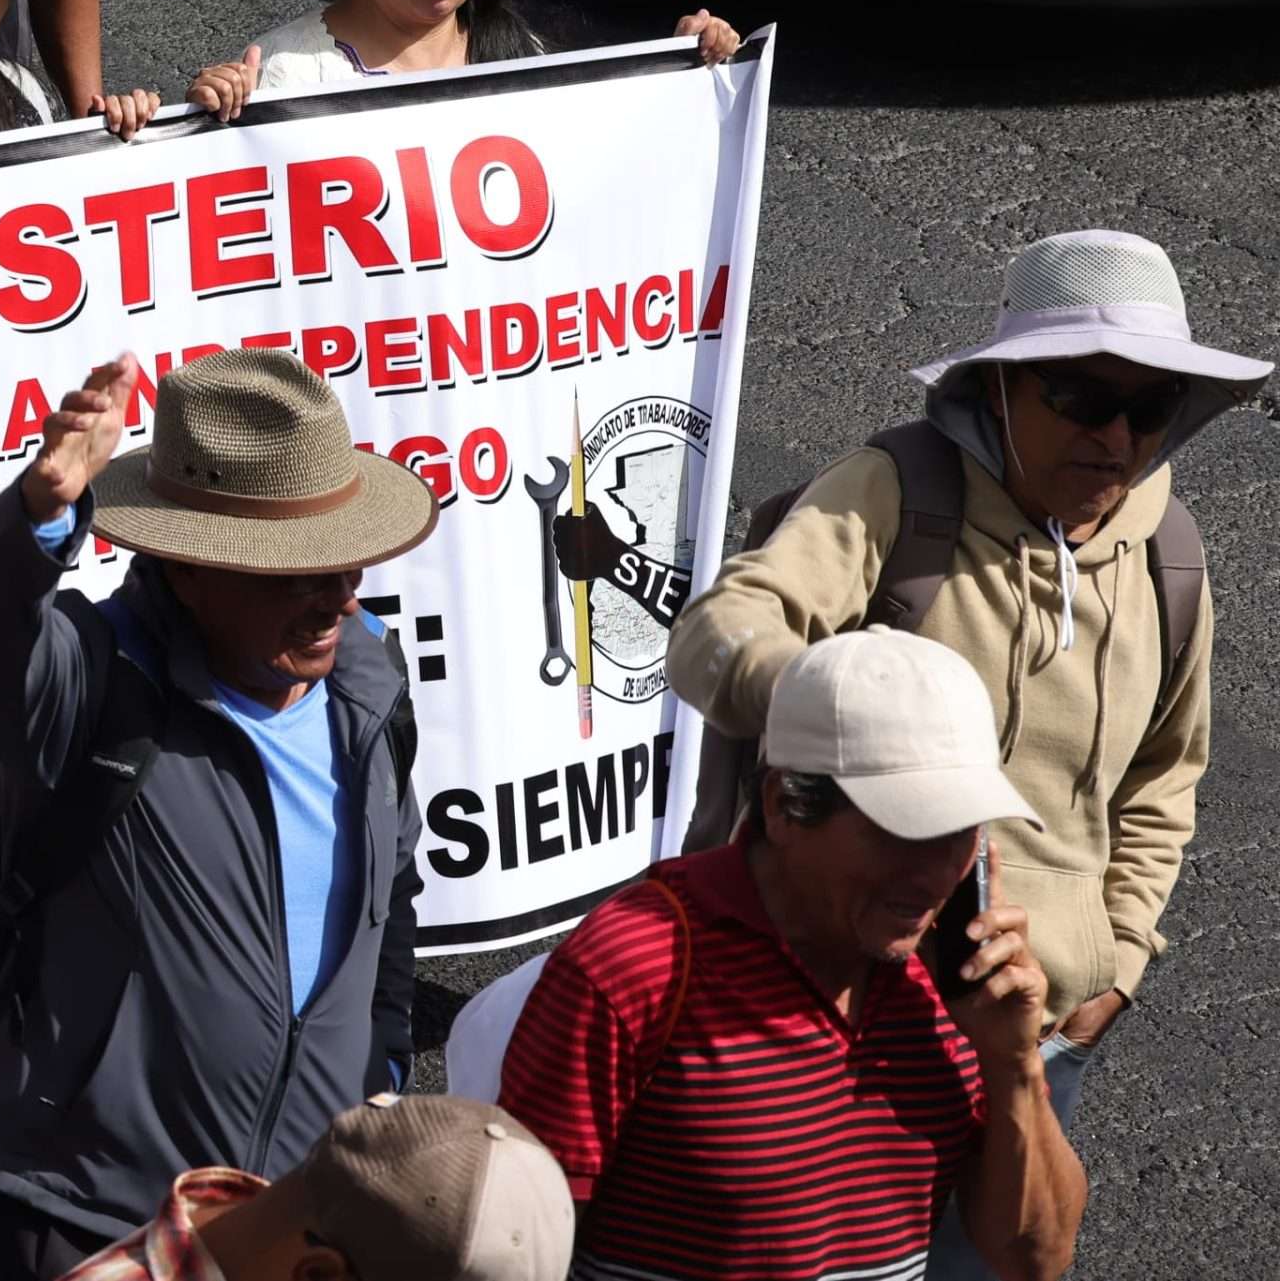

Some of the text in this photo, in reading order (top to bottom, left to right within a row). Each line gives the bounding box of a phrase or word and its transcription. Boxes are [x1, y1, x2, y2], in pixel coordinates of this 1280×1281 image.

[584, 415, 623, 465] SINDICATO
[624, 408, 636, 429] DE
[637, 403, 711, 440] TRABAJADORES
[623, 677, 635, 697] DE
